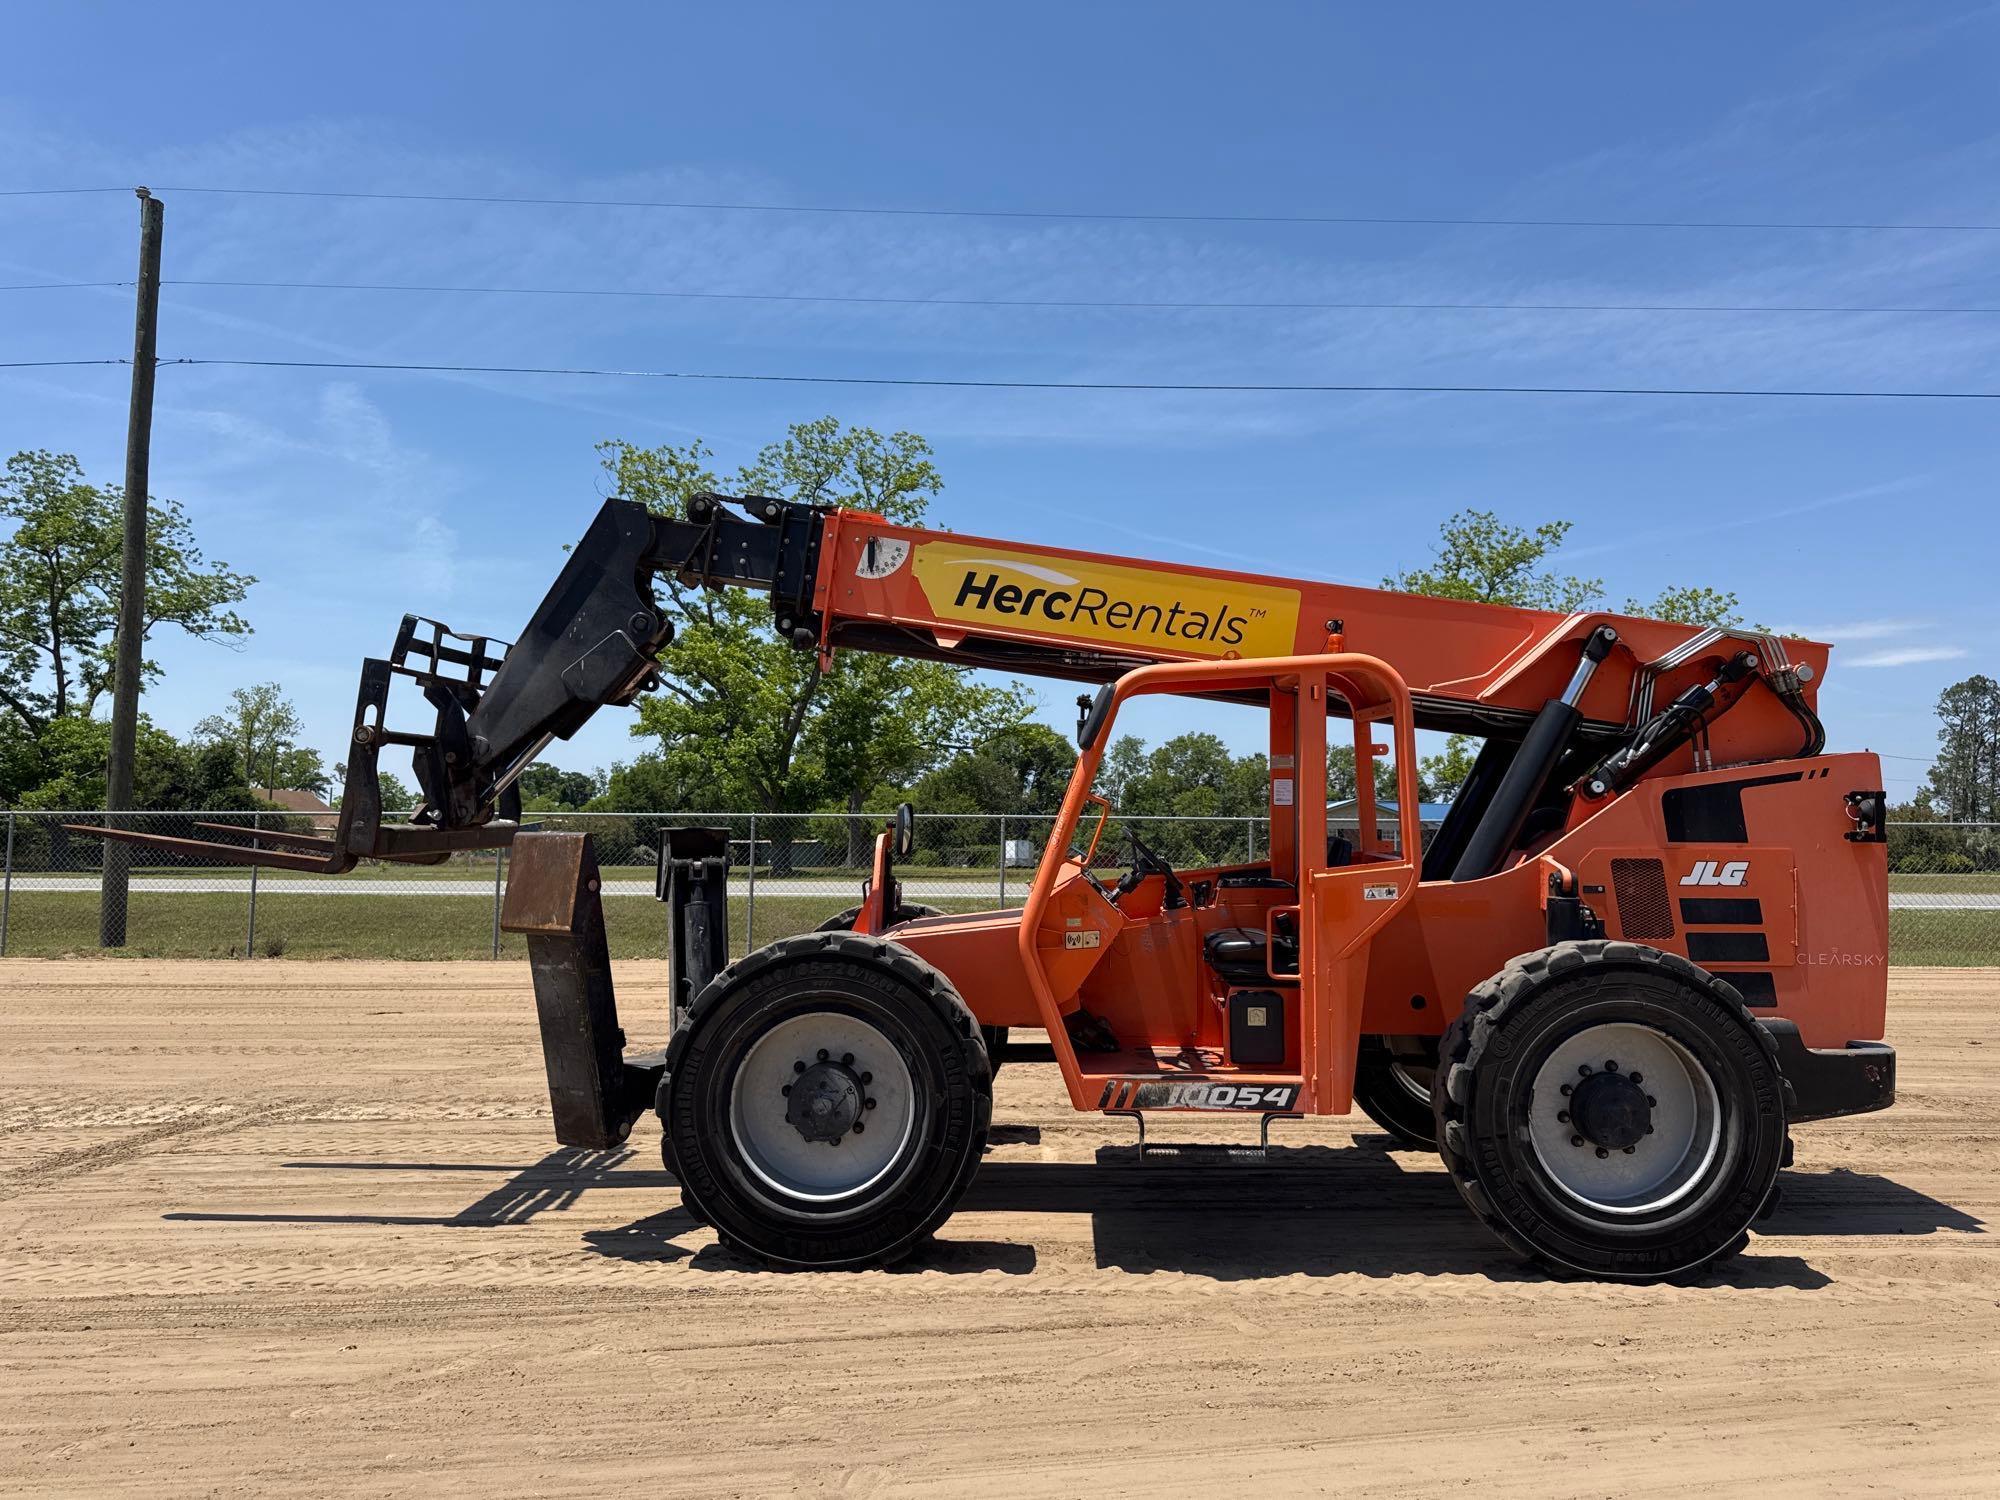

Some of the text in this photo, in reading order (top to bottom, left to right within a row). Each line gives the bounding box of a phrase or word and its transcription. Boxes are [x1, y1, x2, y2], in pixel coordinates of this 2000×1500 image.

[954, 571, 1248, 645] HercRentals
[1679, 861, 1750, 886] JLG
[1168, 1085, 1292, 1107] 10054
